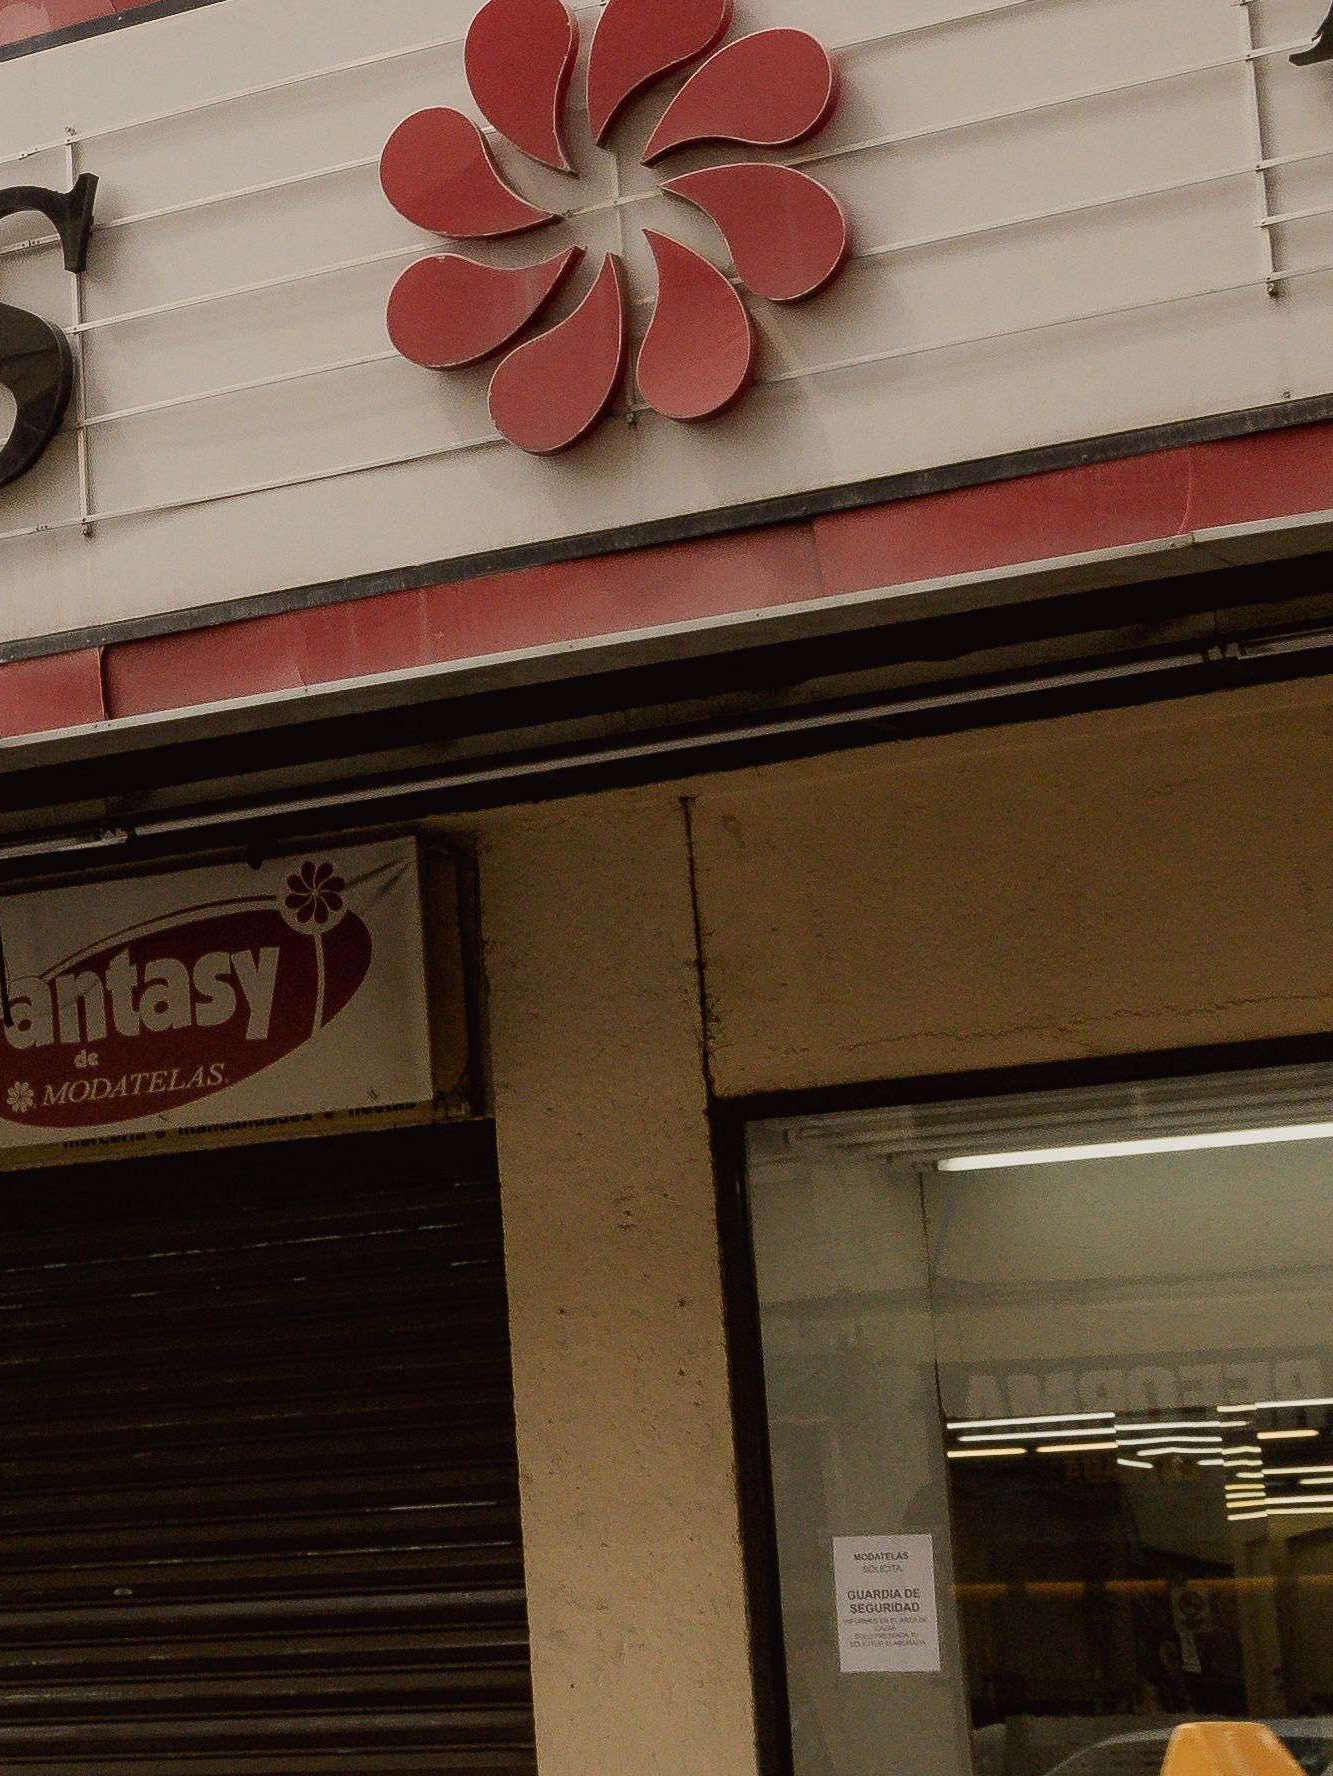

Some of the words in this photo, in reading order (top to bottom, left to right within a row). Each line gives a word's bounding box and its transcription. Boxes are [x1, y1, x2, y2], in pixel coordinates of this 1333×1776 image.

[74, 1049, 99, 1068] de
[42, 1062, 226, 1107] MODATELAS
[853, 1551, 910, 1562] MODATELAS
[847, 1589, 902, 1601] GUARDIA
[904, 1588, 921, 1599] DE
[849, 1602, 920, 1614] SEGURIDAD
